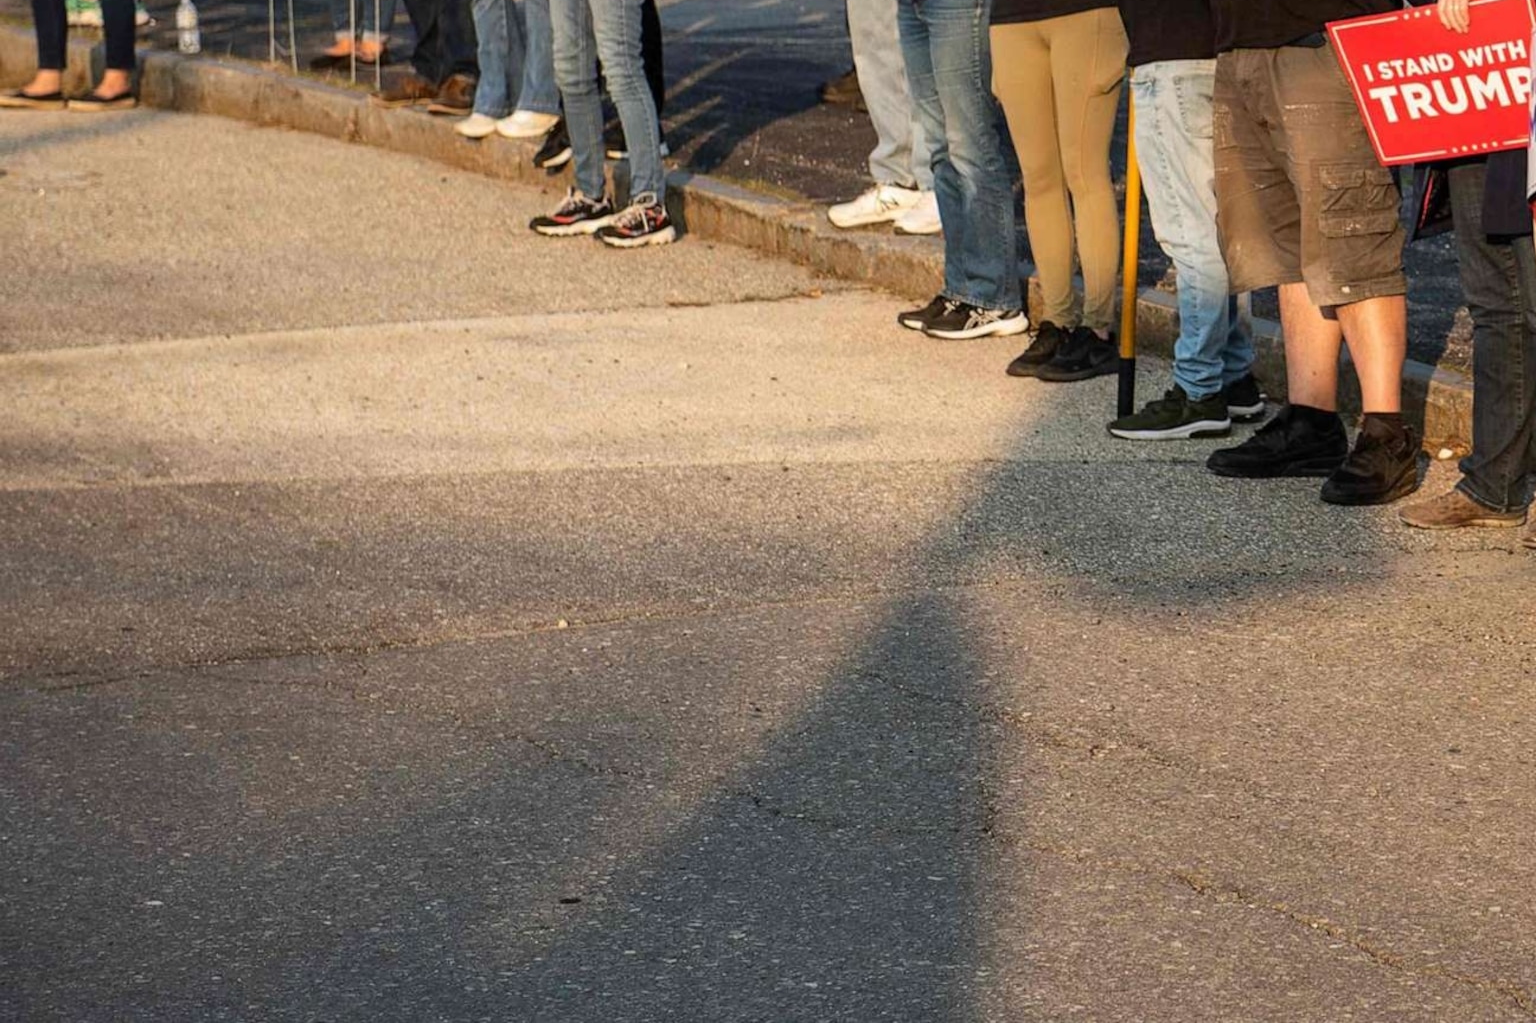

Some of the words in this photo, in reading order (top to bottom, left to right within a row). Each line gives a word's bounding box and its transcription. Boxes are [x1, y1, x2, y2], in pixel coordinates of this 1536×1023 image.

[1363, 64, 1374, 82] I
[1377, 52, 1455, 80] STAND
[1458, 39, 1528, 69] WITH
[1368, 66, 1531, 124] TRUMP
